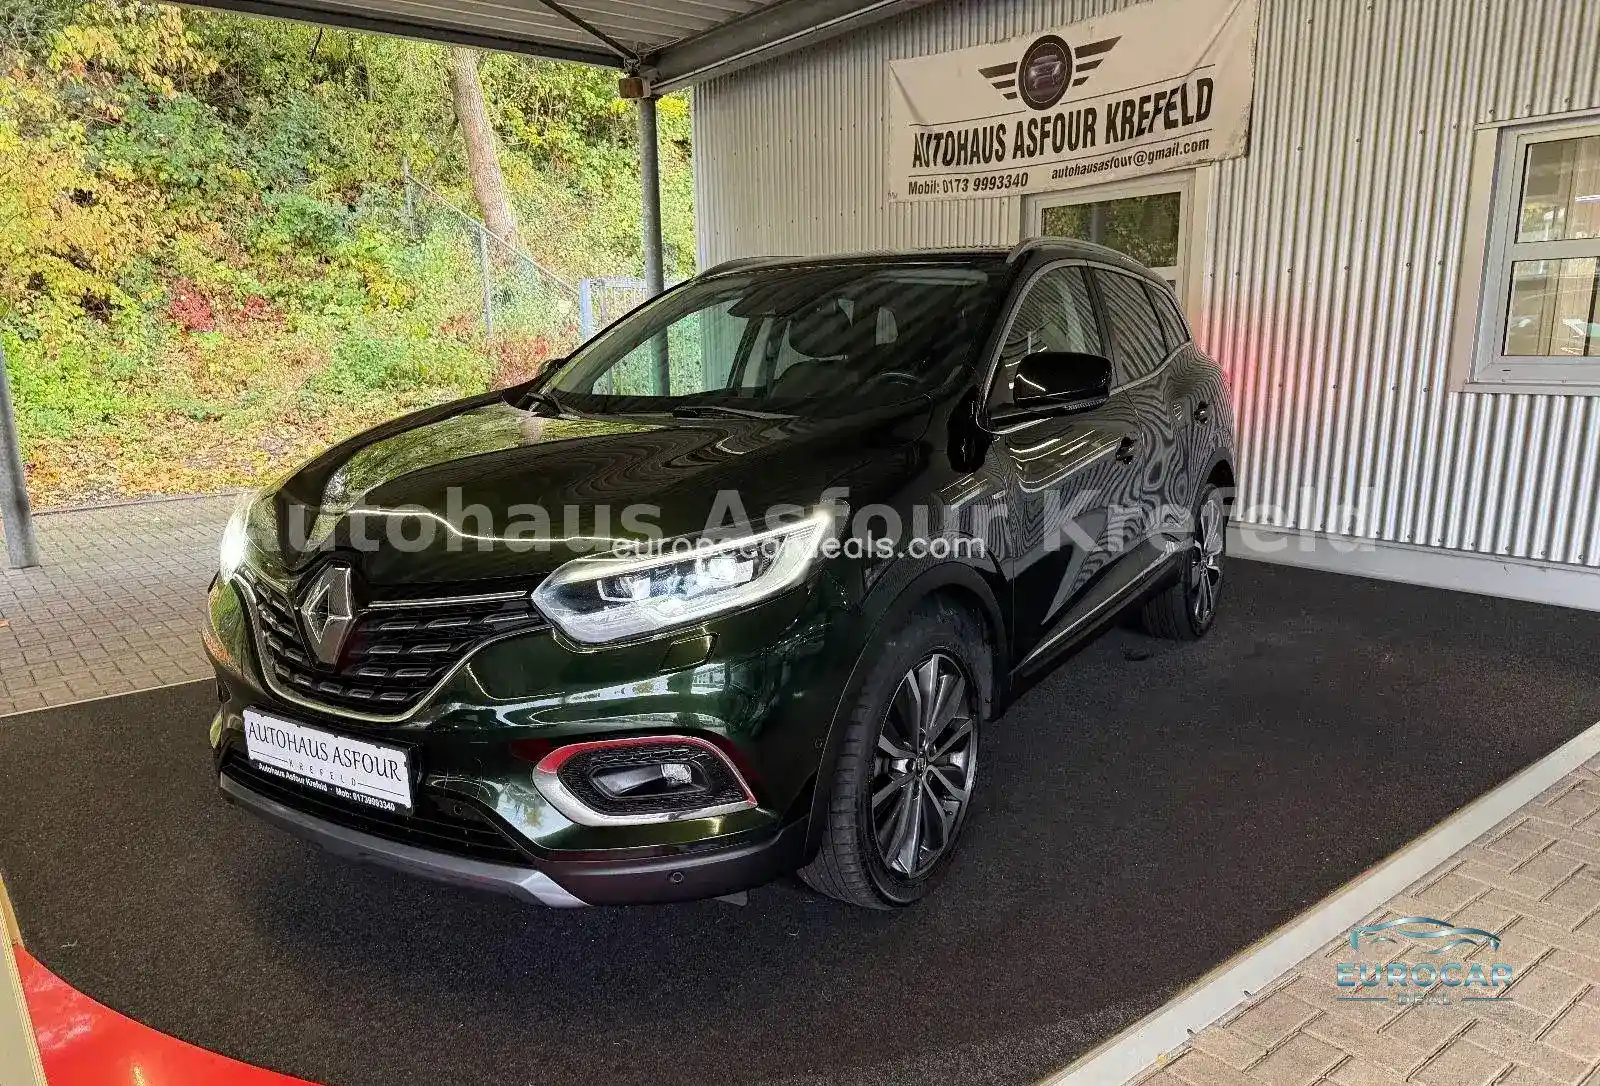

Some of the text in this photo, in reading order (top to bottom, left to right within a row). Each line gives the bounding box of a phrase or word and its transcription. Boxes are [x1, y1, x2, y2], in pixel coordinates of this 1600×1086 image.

[912, 77, 1214, 169] AUTOHAUS ASFOUR KREFELD
[1051, 138, 1210, 180] autohausasfour@gmail.com
[908, 172, 1029, 196] Mobil: 0173 9993340
[248, 721, 402, 781] AUTOHAUS ASFOUR
[285, 772, 306, 785] Asfour
